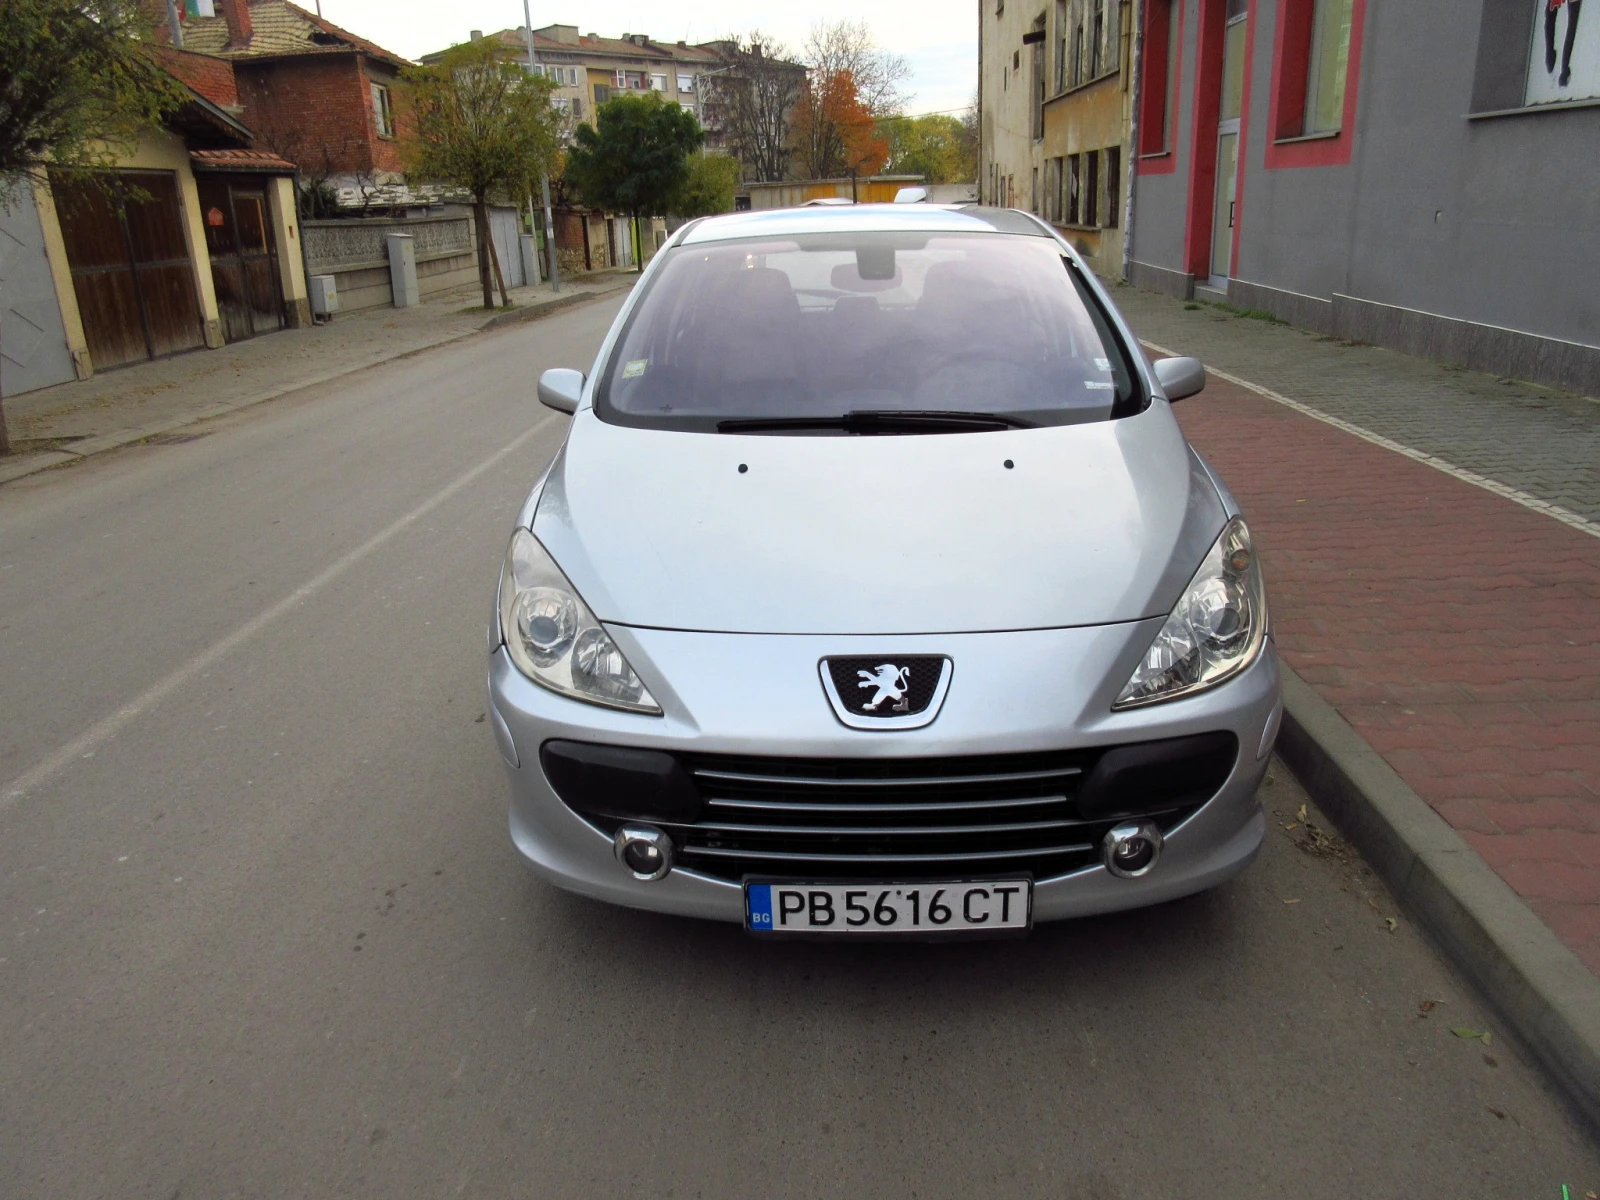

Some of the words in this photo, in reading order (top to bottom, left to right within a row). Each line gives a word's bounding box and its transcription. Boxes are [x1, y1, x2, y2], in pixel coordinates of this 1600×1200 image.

[752, 912, 770, 923] BG
[778, 890, 836, 926] PB
[845, 889, 953, 926] 5616
[963, 887, 1020, 923] CT
